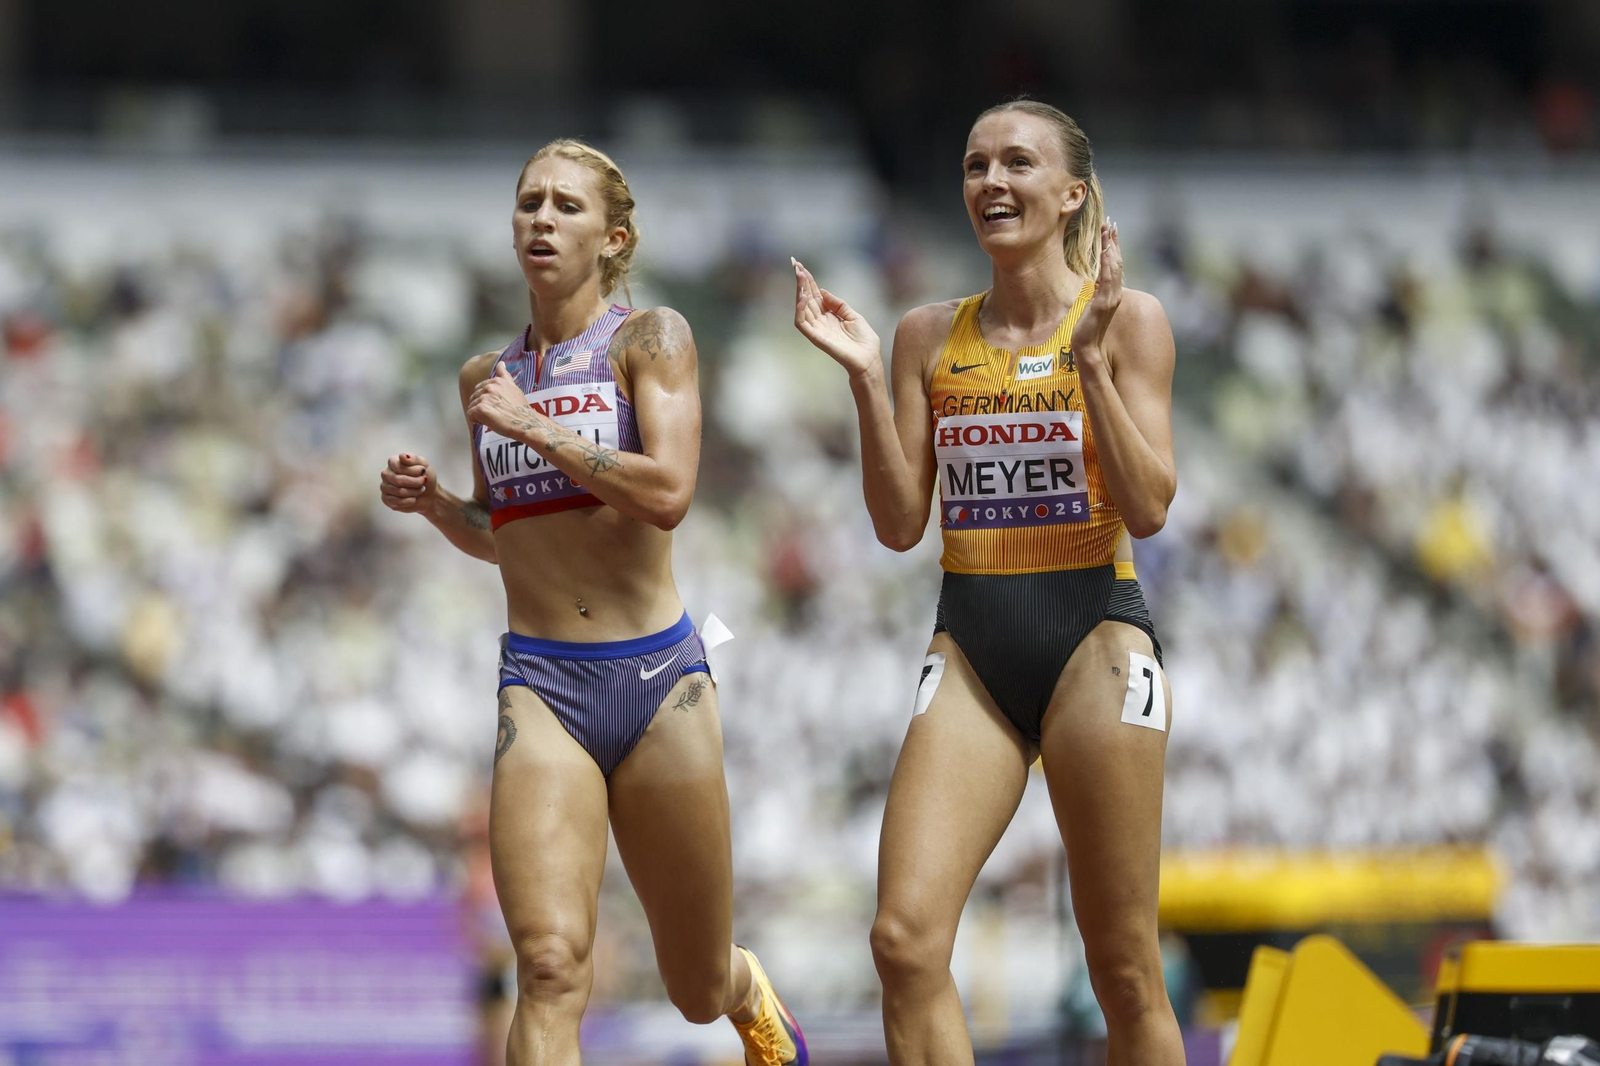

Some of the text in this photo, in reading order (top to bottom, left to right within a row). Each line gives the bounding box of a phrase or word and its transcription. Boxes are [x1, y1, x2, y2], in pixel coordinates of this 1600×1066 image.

[1018, 358, 1053, 375] WGV
[942, 388, 1075, 417] GERMANY
[937, 421, 1079, 448] HONDA
[946, 458, 1076, 497] MEYER
[1142, 667, 1154, 717] 7
